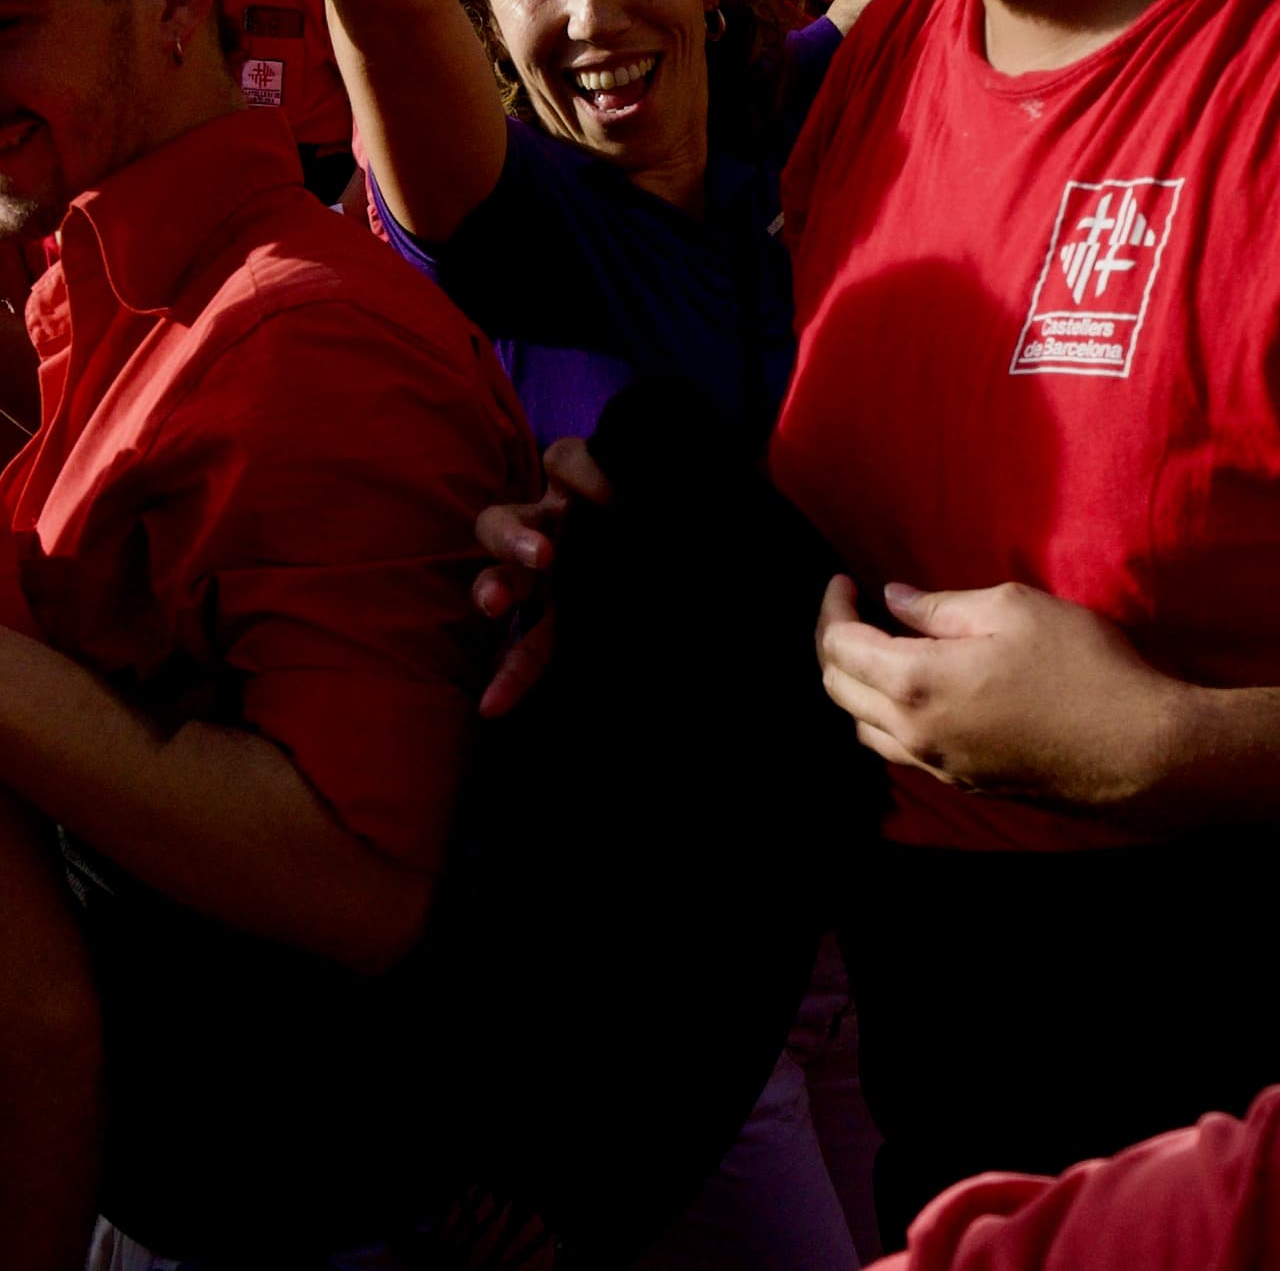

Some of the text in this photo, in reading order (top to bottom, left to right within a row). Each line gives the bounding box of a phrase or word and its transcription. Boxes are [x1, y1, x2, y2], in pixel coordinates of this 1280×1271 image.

[1041, 318, 1115, 338] Castellers
[1024, 336, 1123, 359] de Barcelona
